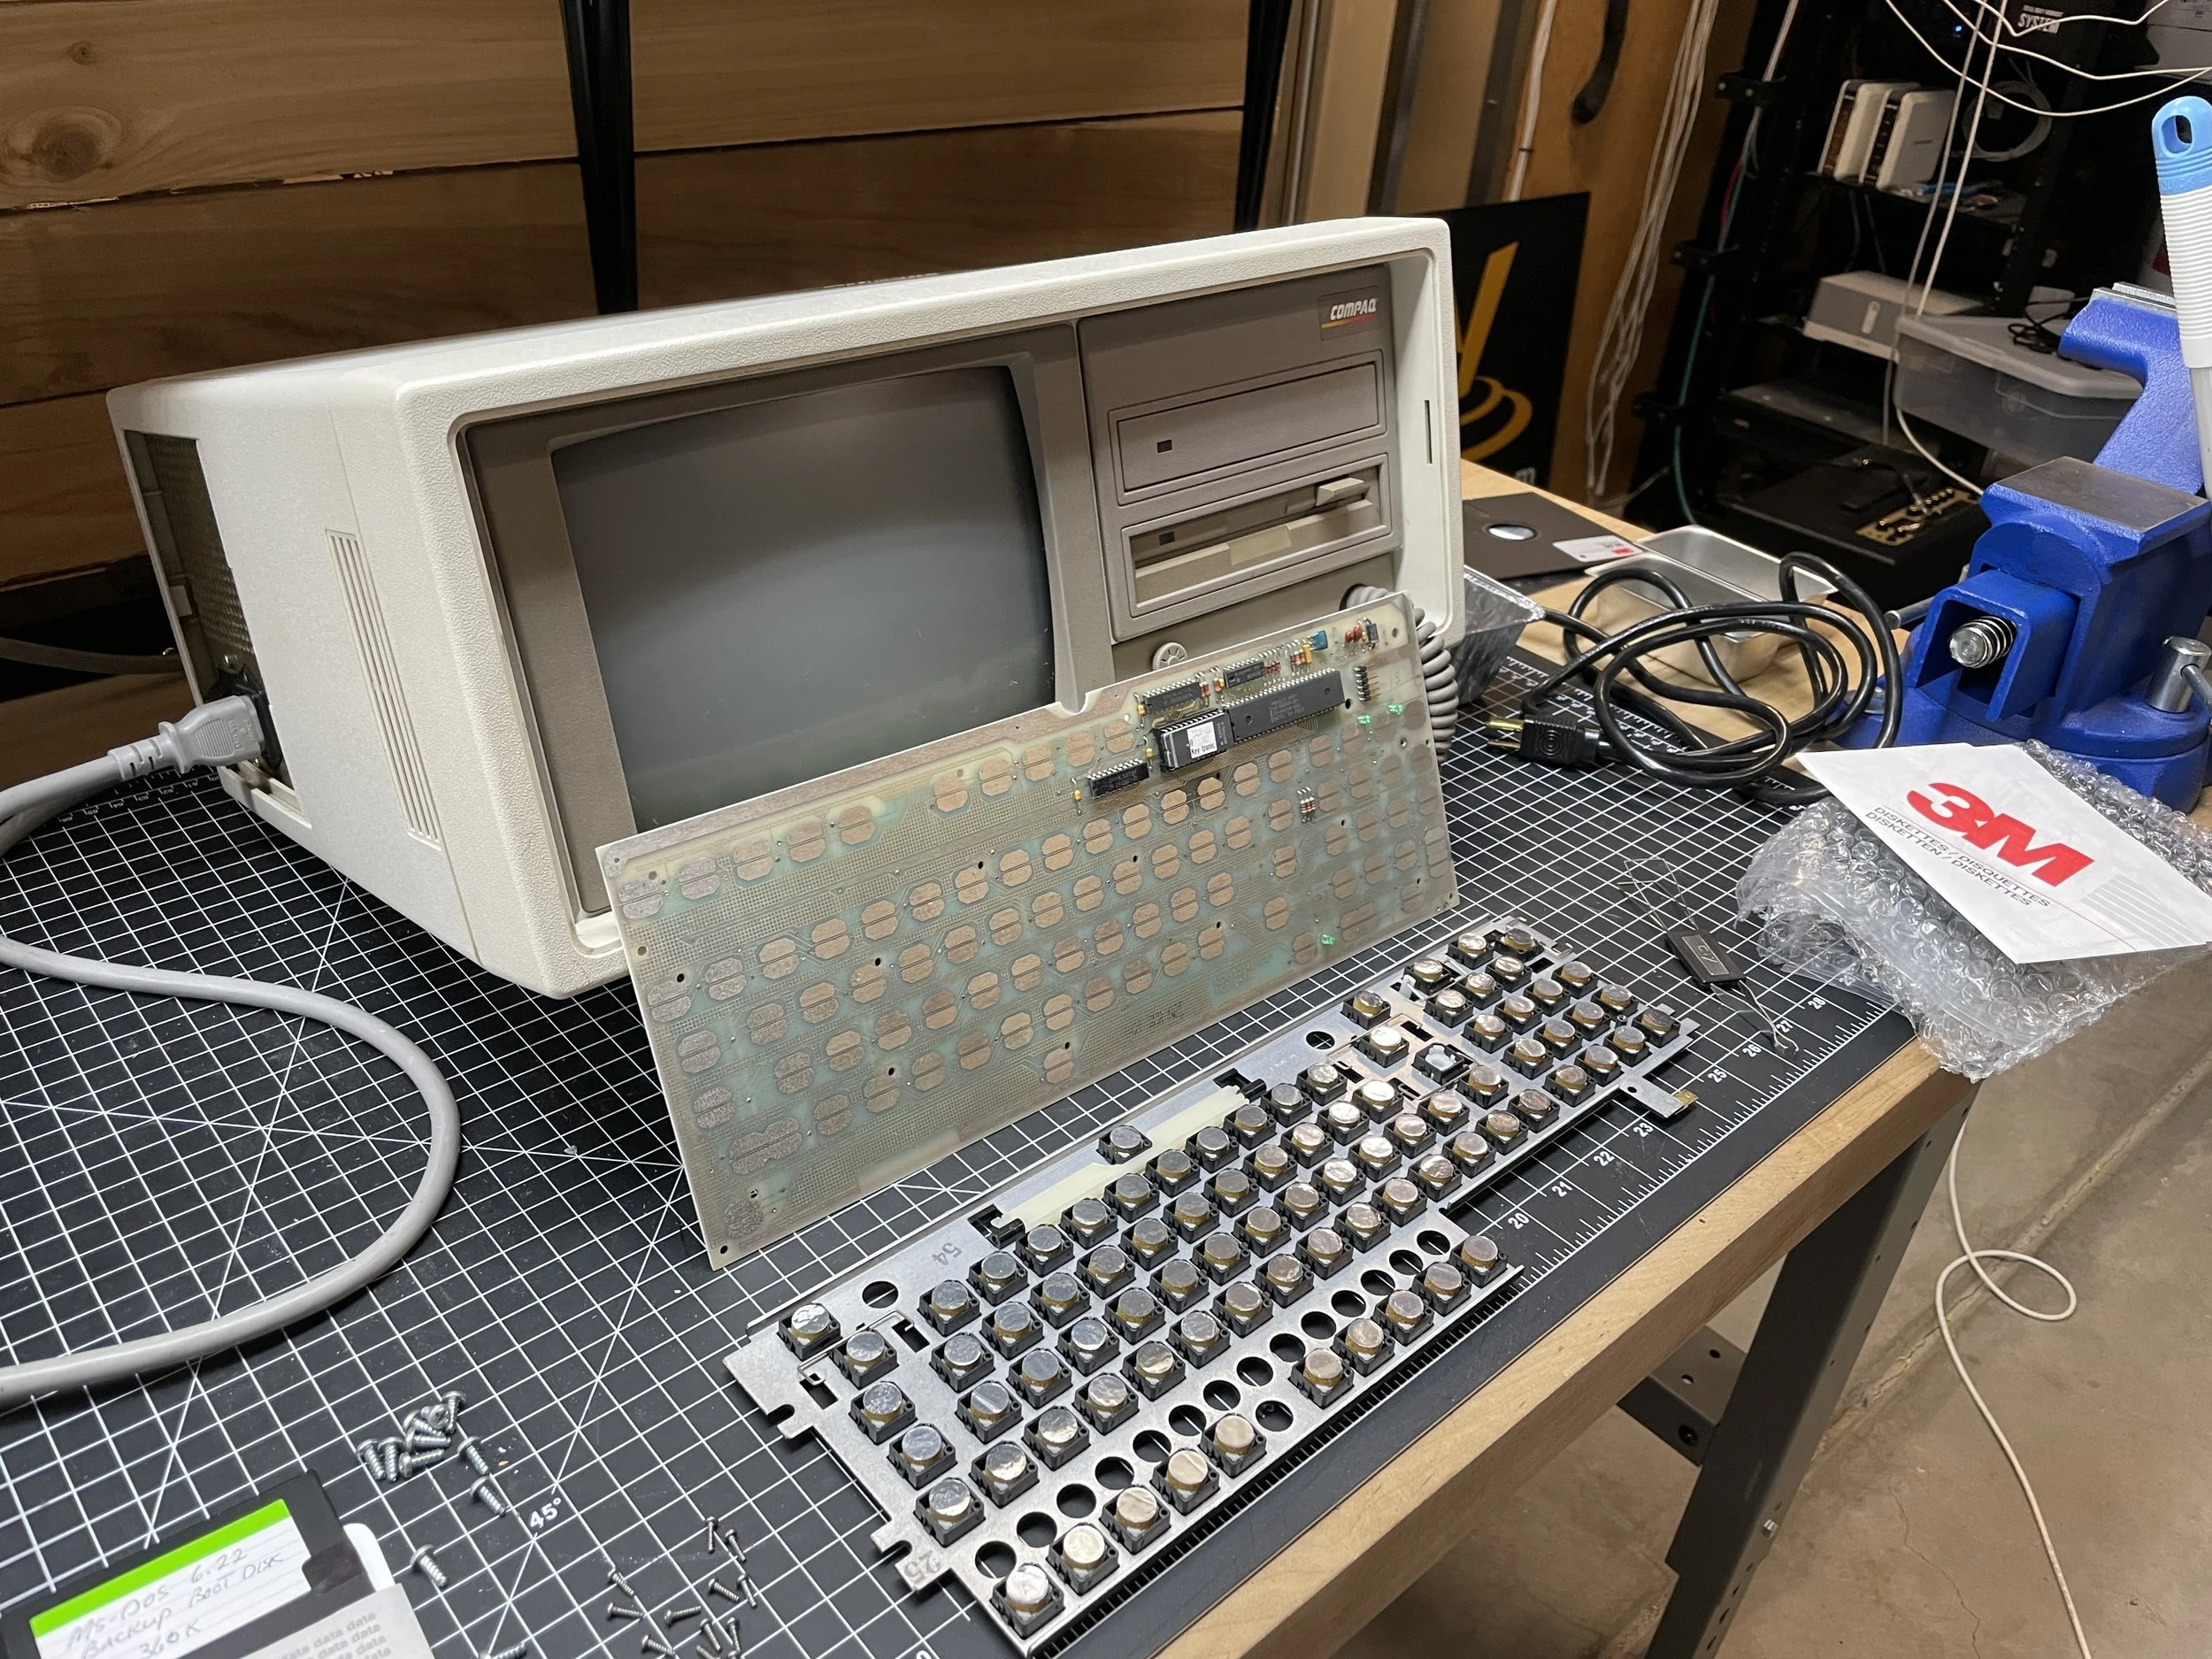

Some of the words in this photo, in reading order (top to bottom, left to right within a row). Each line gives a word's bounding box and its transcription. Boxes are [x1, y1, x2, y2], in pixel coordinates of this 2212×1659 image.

[1330, 297, 1377, 320] COMPAQ
[1907, 782, 2094, 887] 3M
[1865, 811, 1943, 856] DISKETTEN
[1951, 859, 2032, 906] DISKETTES
[1873, 807, 1950, 852] DISKETTES
[1958, 855, 2051, 907] DISQUETTES
[1508, 1212, 1530, 1230] 20
[1551, 1180, 1573, 1197] 21
[1593, 1150, 1615, 1167] 22
[1632, 1122, 1654, 1138] 23
[1708, 1068, 1727, 1083] 25
[1742, 1043, 1762, 1057] 26
[1776, 1019, 1793, 1033] 27
[1808, 996, 1826, 1010] 28
[931, 1241, 963, 1267] 54
[530, 1497, 562, 1528] 45°
[903, 1550, 941, 1584] 25
[67, 1585, 170, 1649] MS-DOS
[190, 1548, 248, 1583] 6.22
[188, 1571, 235, 1609] BOOT
[313, 1629, 343, 1647] data
[347, 1612, 376, 1632] data
[319, 1640, 349, 1659] data
[351, 1624, 380, 1642] data
[357, 1635, 387, 1655] data
